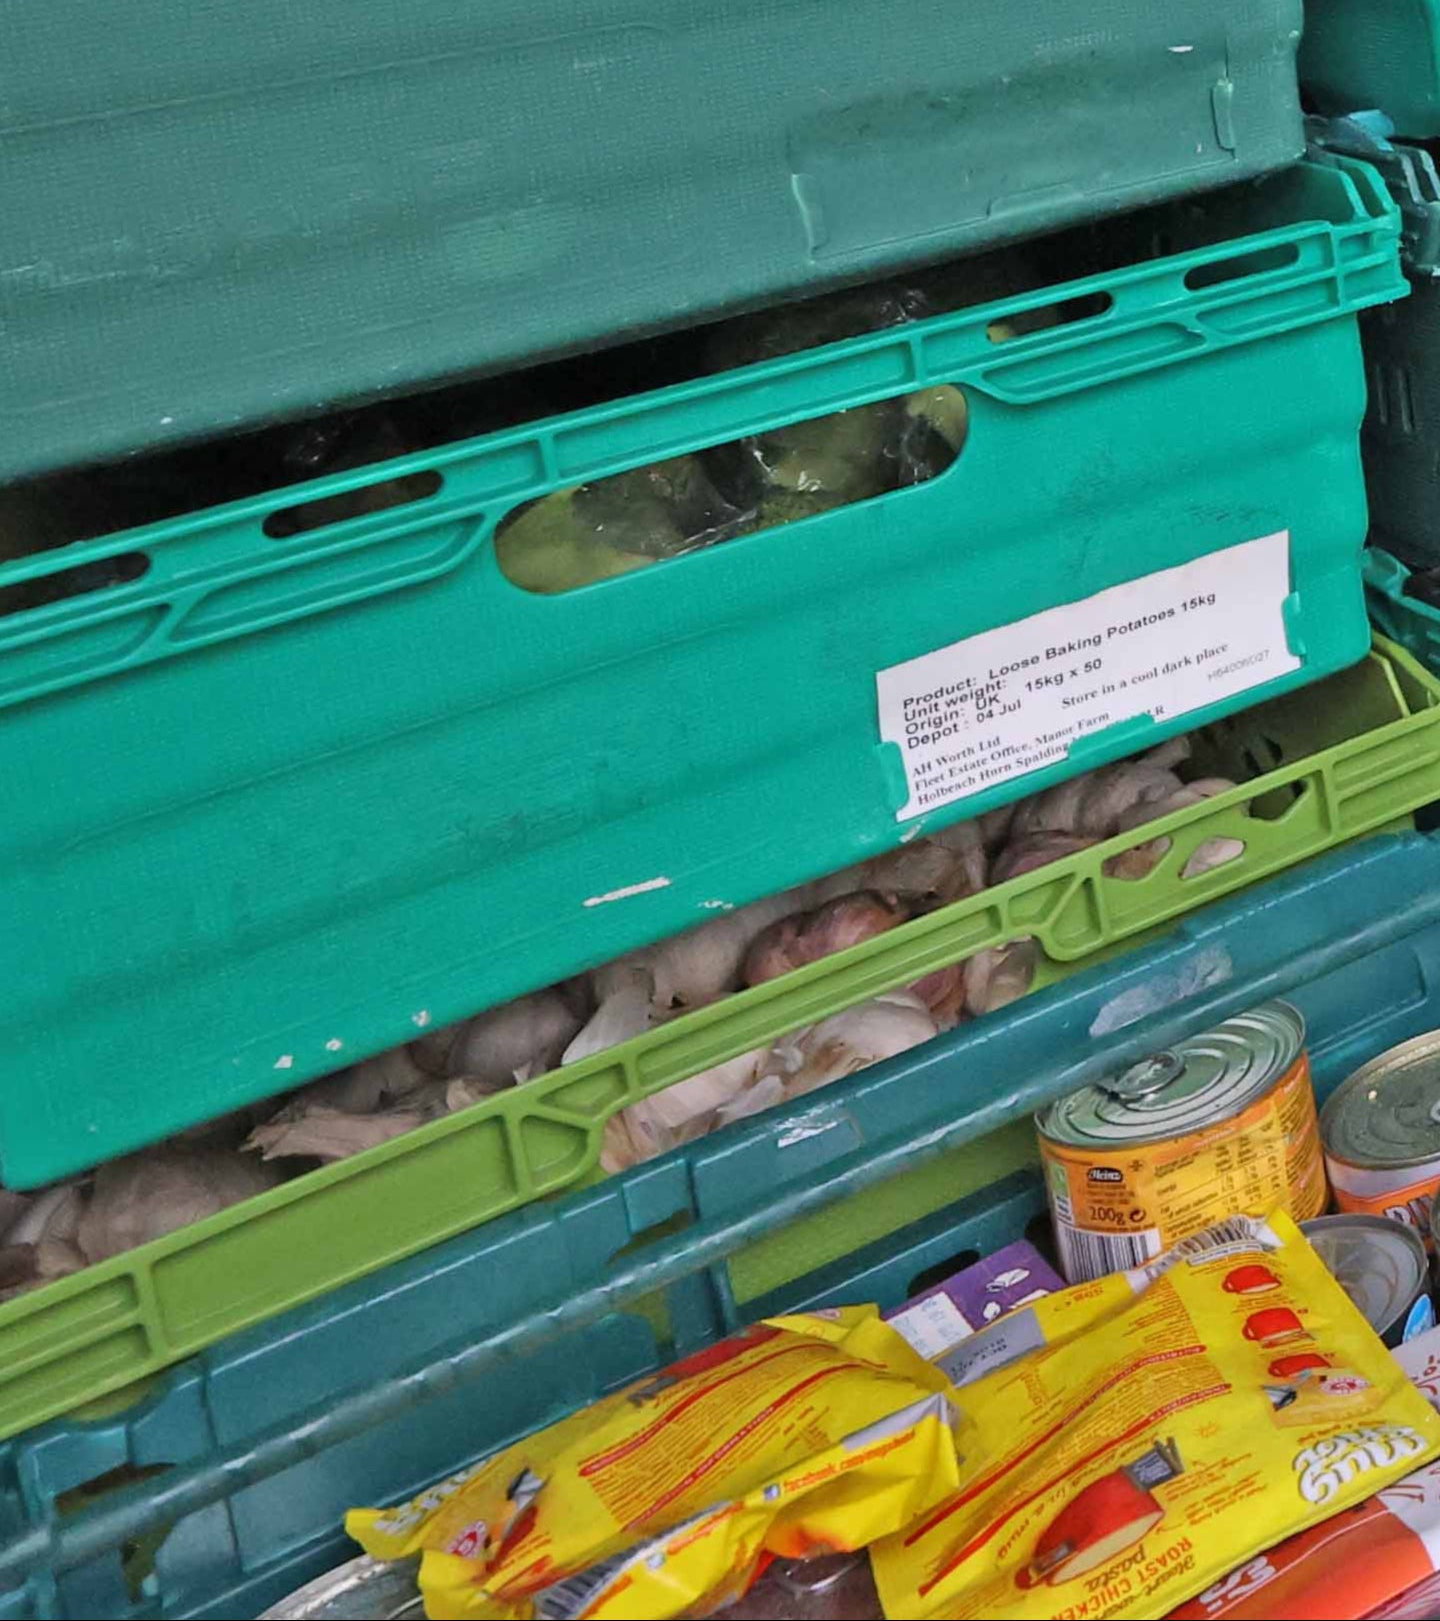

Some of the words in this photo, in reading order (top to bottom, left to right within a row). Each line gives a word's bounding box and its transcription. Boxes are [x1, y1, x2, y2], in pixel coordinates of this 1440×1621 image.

[903, 677, 977, 710] Product:
[988, 655, 1040, 680] Loose
[1045, 633, 1102, 660] Baking
[1106, 606, 1176, 639] Potatoes
[1182, 592, 1216, 612] 15kg
[1062, 690, 1098, 709] Store
[1103, 682, 1115, 696] in
[1119, 679, 1127, 689] a
[1131, 665, 1158, 685] cool
[1162, 655, 1193, 676] dark
[1196, 642, 1229, 665] place
[904, 702, 939, 723] Unit
[948, 679, 1007, 709] weight:
[1025, 671, 1064, 692] 15kg
[1069, 669, 1079, 678] x
[1084, 658, 1102, 673] 50
[905, 707, 965, 735] Origin:
[975, 693, 1001, 711] UK
[908, 724, 959, 750] Depot
[976, 709, 994, 724] 04
[1000, 699, 1021, 717] Jul
[914, 772, 945, 792] Fleet
[949, 755, 988, 779] Estate
[1035, 727, 1074, 747] Manor
[1078, 712, 1110, 732] Farm
[938, 746, 976, 769] Worth
[978, 735, 1001, 752] Ltd
[917, 771, 977, 806] Holbeach
[1088, 1206, 1125, 1226] 200g
[1083, 1544, 1147, 1593] pasta
[1137, 1536, 1193, 1584] ROAST
